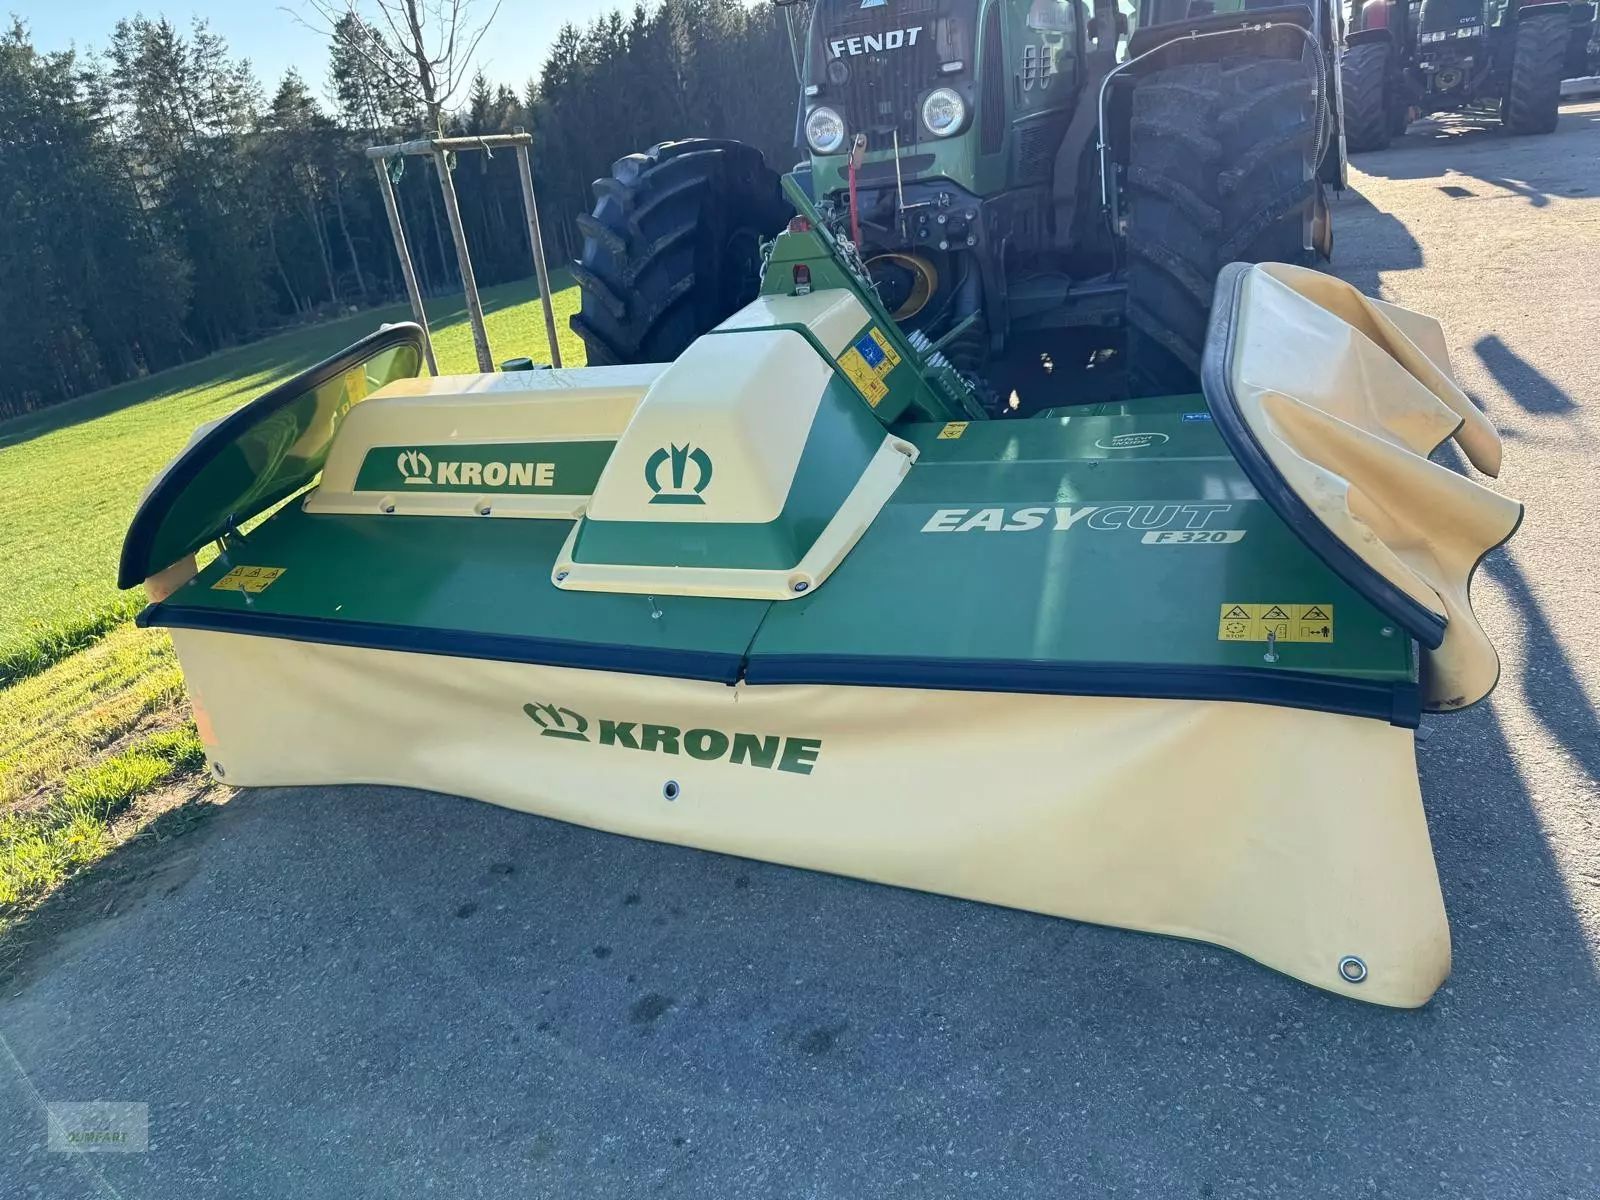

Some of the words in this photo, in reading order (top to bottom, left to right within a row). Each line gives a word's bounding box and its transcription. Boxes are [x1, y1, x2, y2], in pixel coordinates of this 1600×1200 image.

[830, 26, 923, 58] FENDT
[437, 461, 556, 487] KRONE
[919, 504, 1232, 533] EASYCUT
[1155, 532, 1170, 543] F
[1177, 531, 1228, 544] 320
[598, 719, 822, 775] KRONE
